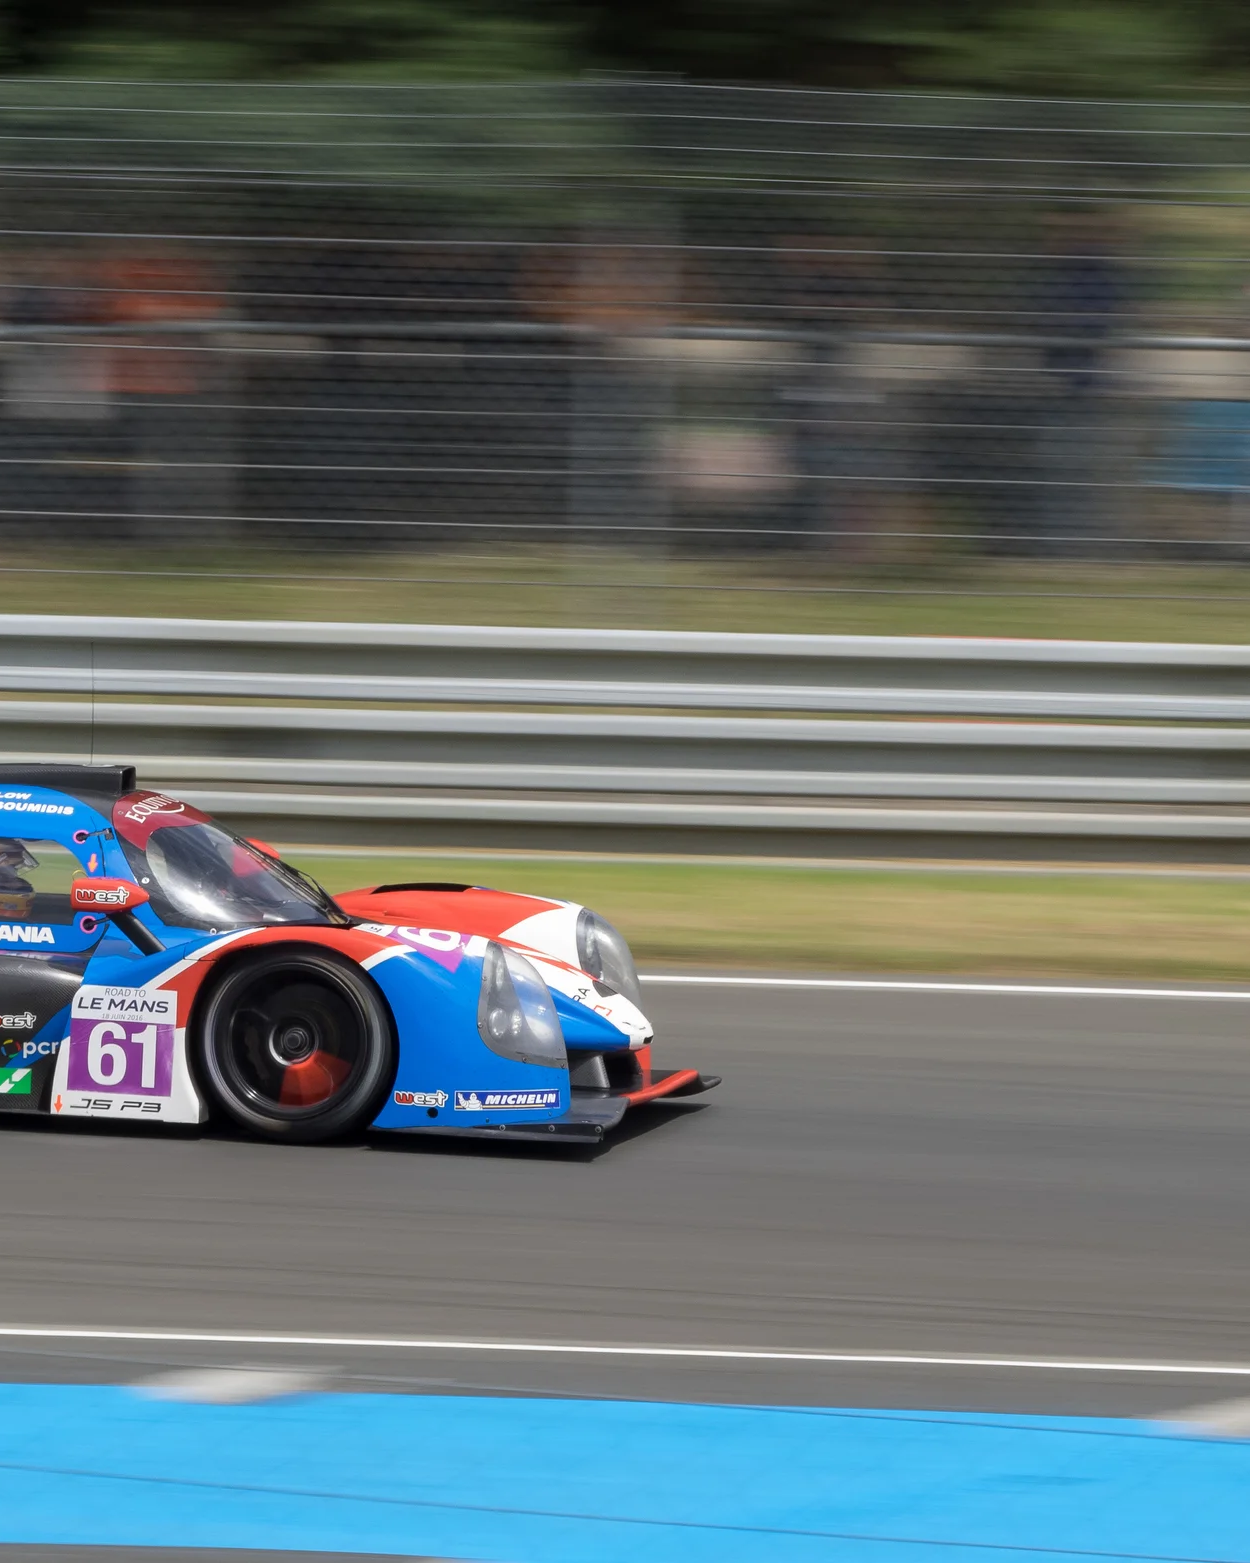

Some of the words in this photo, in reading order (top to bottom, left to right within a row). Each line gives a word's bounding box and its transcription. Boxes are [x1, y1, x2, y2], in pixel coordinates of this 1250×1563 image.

[76, 886, 129, 904] west
[105, 988, 131, 997] ROAD
[77, 997, 104, 1010] LE
[107, 998, 169, 1014] MANS
[87, 1021, 157, 1089] 61
[70, 1098, 113, 1110] JS
[394, 1090, 448, 1107] west
[485, 1093, 556, 1105] MICHELIN
